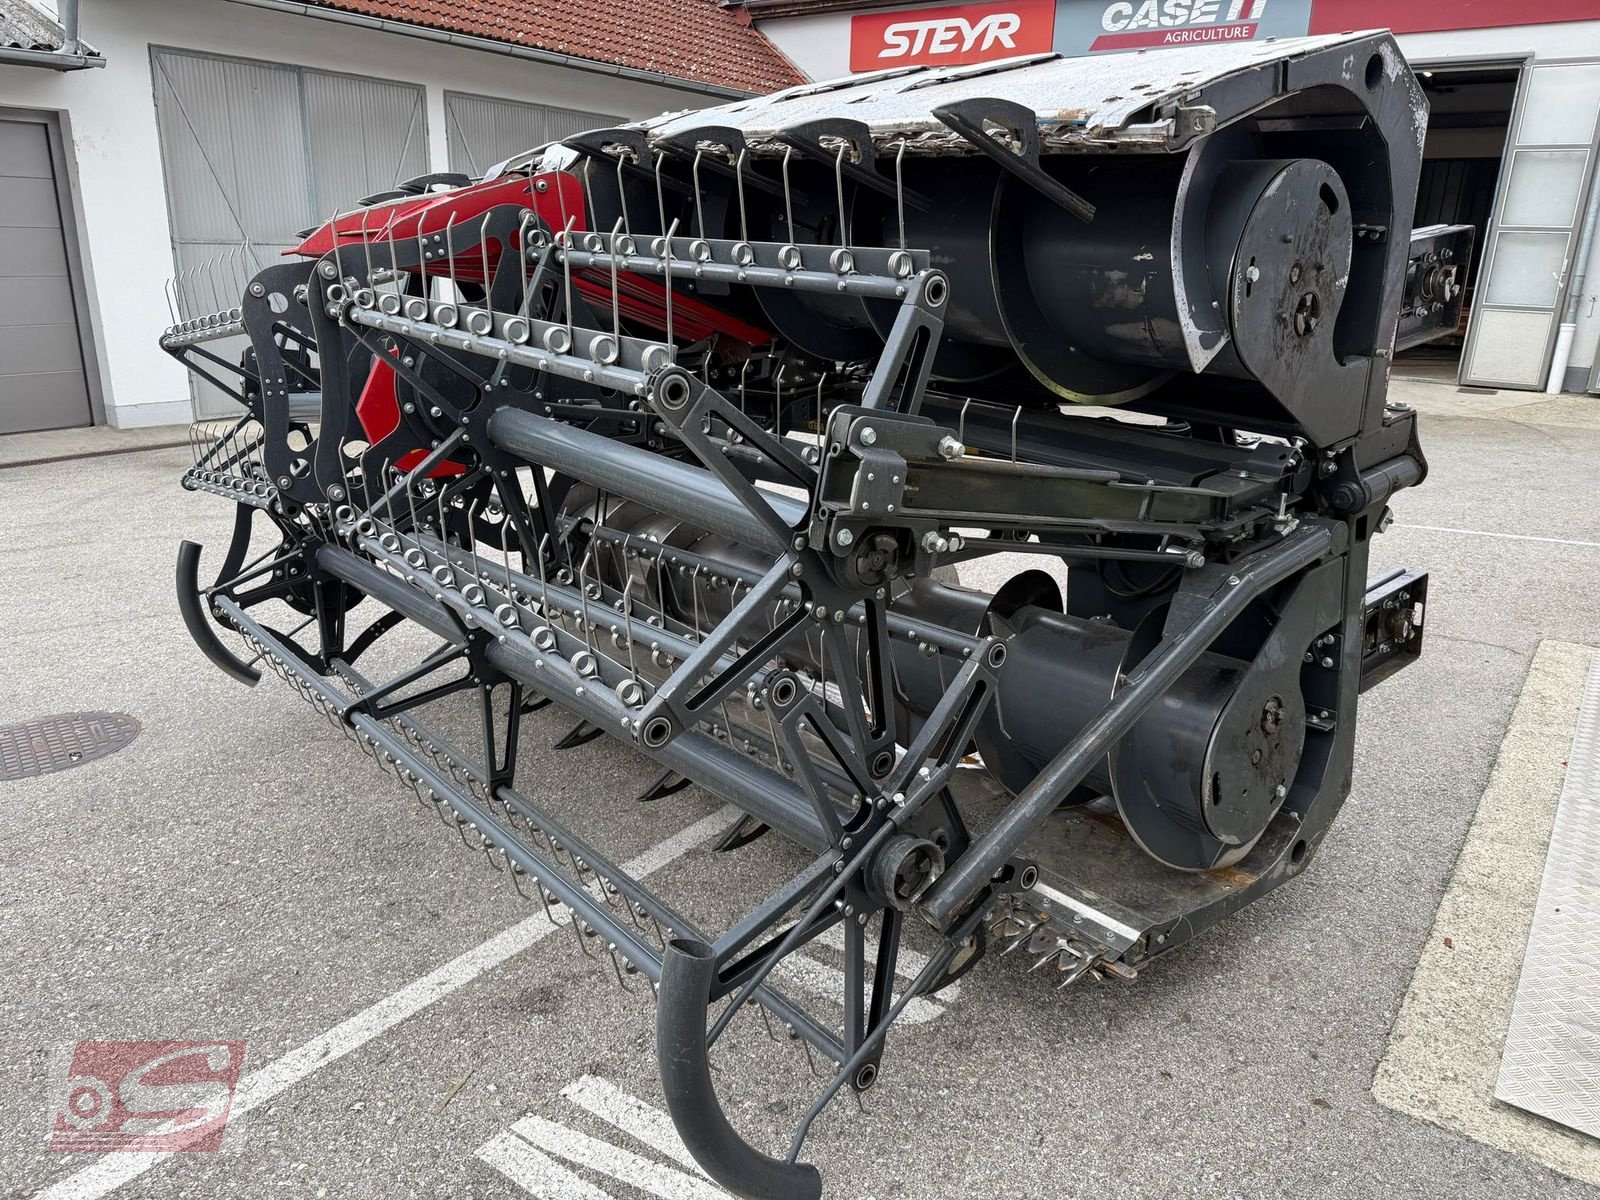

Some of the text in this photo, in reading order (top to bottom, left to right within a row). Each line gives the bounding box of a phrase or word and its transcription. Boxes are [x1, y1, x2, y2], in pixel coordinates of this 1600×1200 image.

[1101, 0, 1219, 32] CASE
[877, 13, 1021, 58] STEYR
[1163, 26, 1250, 44] AGRICULTURE
